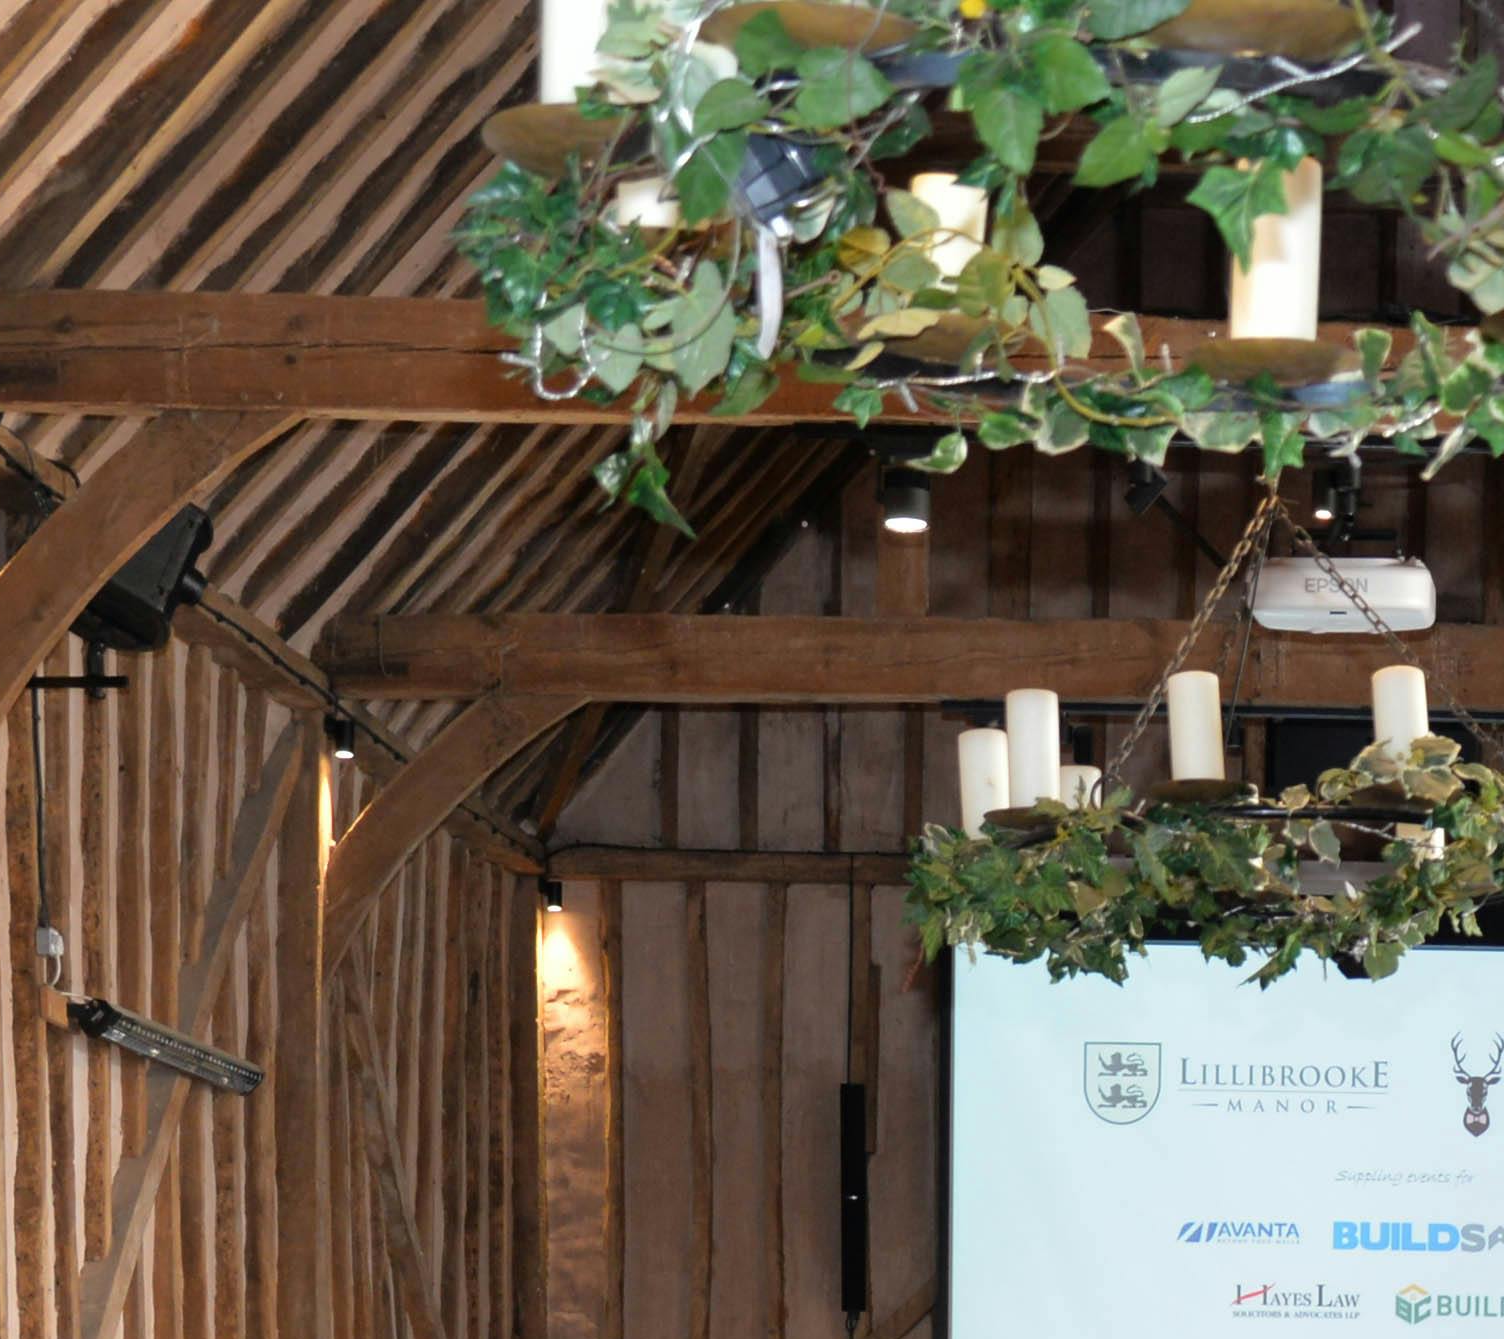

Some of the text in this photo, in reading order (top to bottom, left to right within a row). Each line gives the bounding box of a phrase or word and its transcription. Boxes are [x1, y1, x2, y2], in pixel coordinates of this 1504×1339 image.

[1180, 1057, 1389, 1089] LILLIBROOKE
[1226, 1098, 1338, 1114] MANOR
[1216, 1221, 1300, 1238] AVANTA
